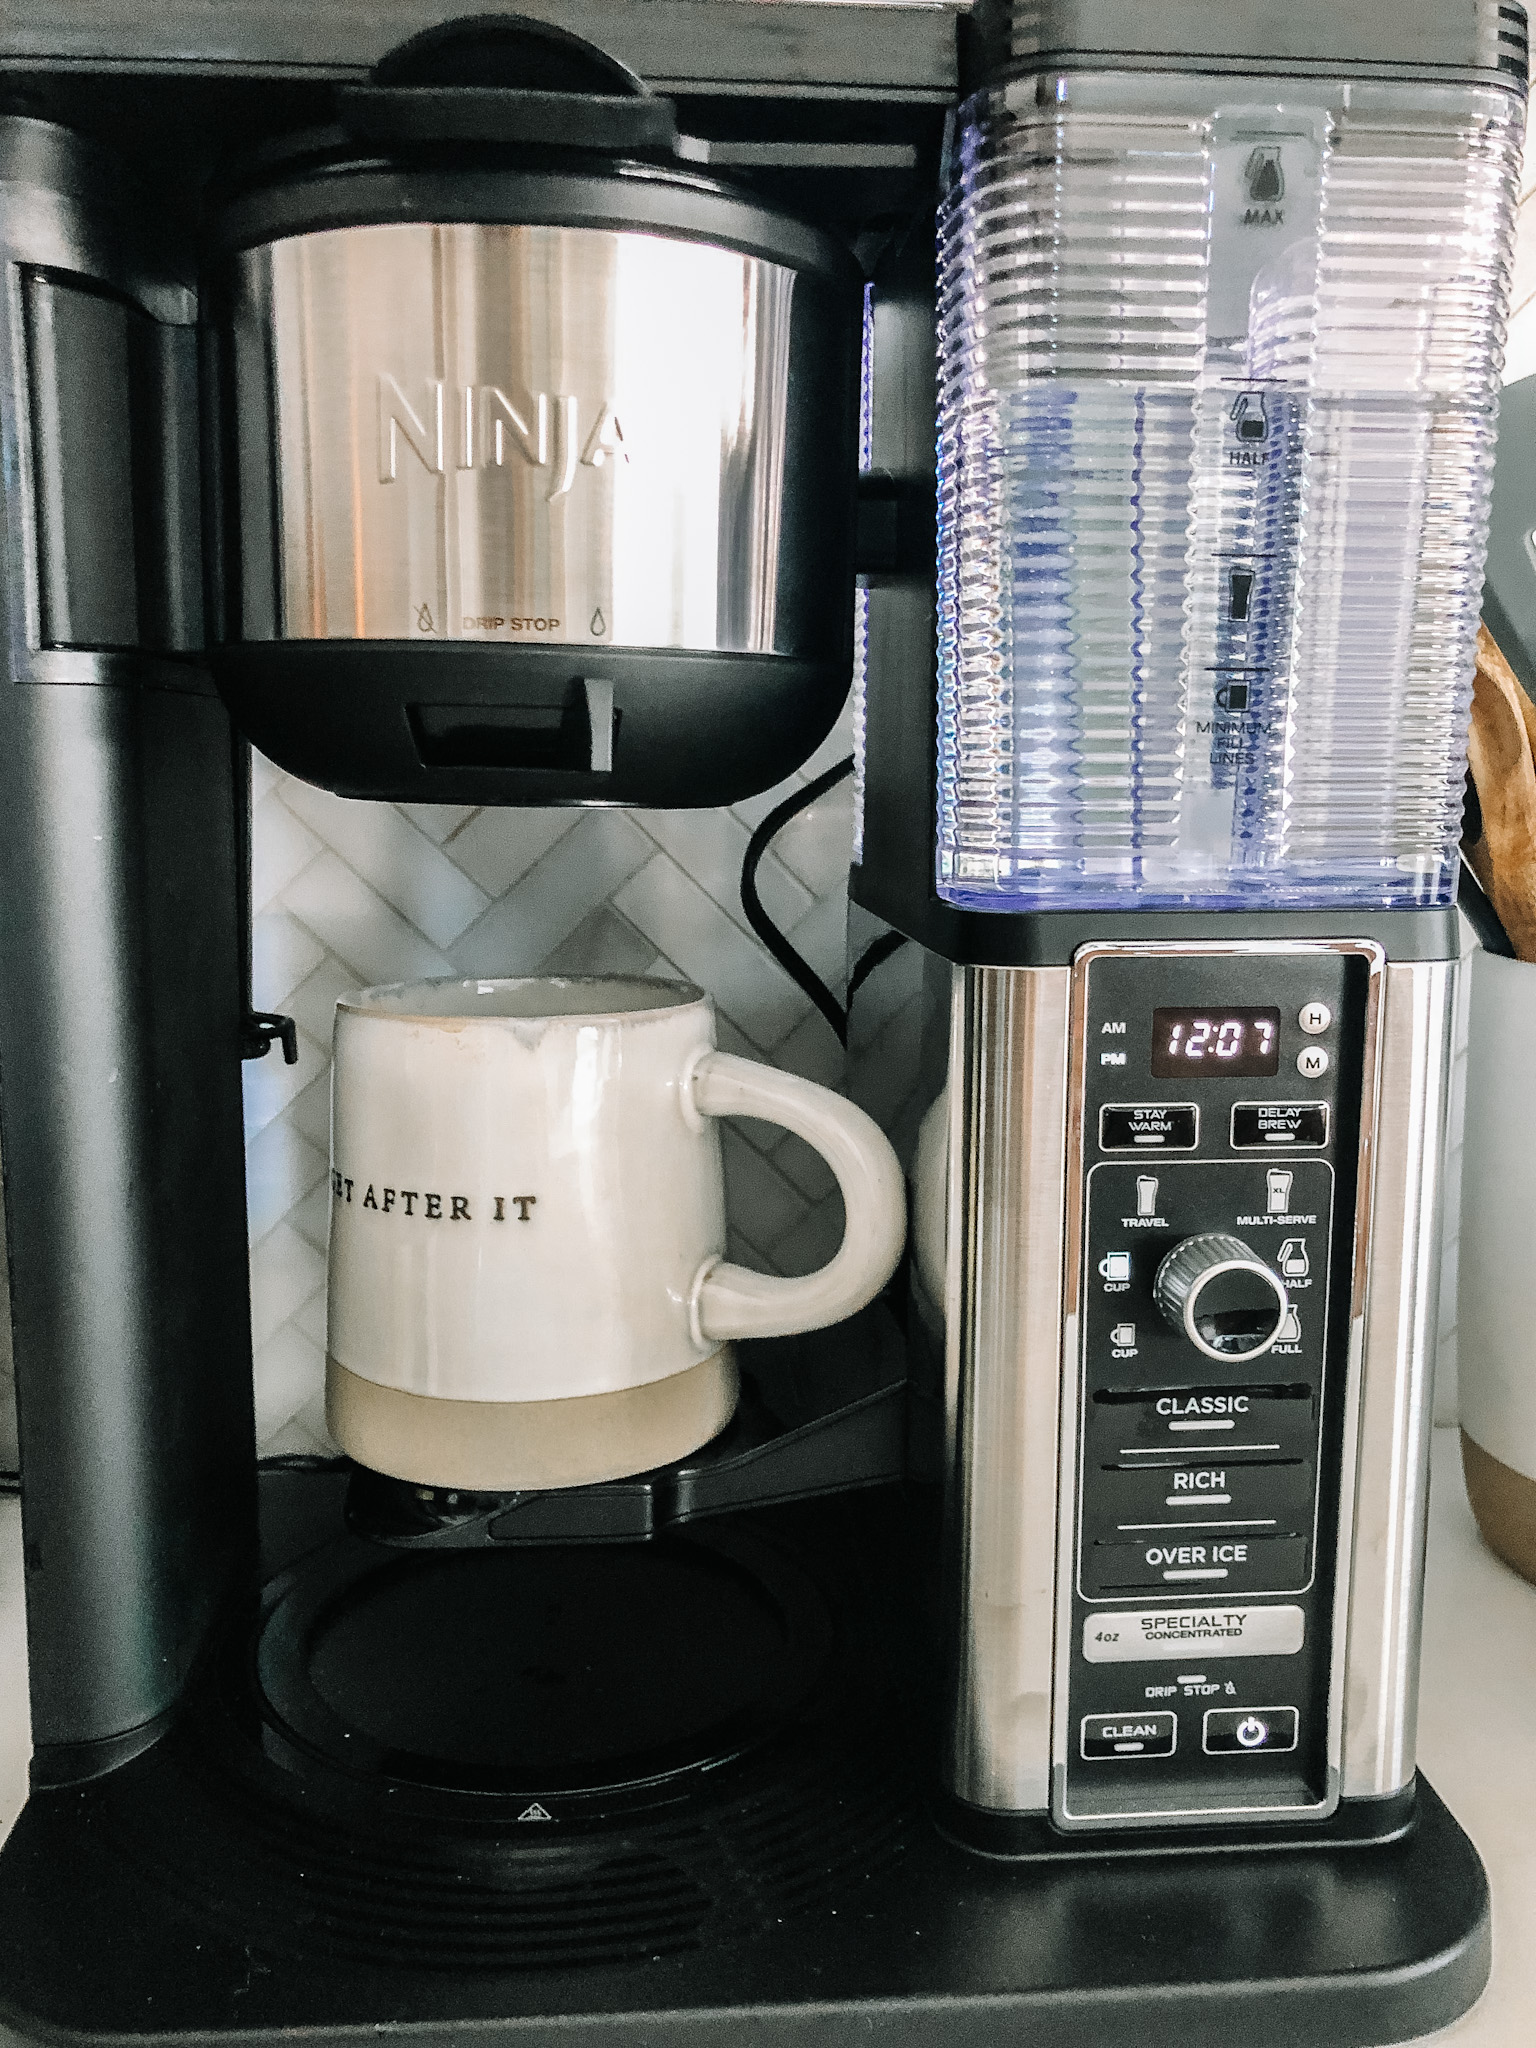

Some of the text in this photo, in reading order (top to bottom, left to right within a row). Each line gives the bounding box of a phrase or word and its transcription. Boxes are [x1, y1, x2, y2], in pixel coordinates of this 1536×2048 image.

[1243, 208, 1284, 225] MAX
[376, 372, 630, 502] NINJA
[1229, 451, 1270, 466] HALF
[462, 616, 560, 631] DRIP STOP
[1195, 721, 1271, 734] MINIMUM
[1217, 737, 1248, 749] FILL
[1210, 752, 1255, 765] LINES
[1310, 1013, 1322, 1025] H
[1101, 1022, 1126, 1034] AM
[1168, 1021, 1274, 1058] 12:07
[1100, 1053, 1126, 1066] PM
[1306, 1058, 1320, 1070] M
[1133, 1110, 1167, 1120] STAY
[1258, 1108, 1302, 1118] DELAY
[1128, 1121, 1171, 1132] WARM
[1258, 1119, 1302, 1130] BREW
[363, 1183, 472, 1221] AFTER
[493, 1195, 537, 1221] IT
[1121, 1217, 1170, 1228] TRAVEL
[1236, 1214, 1317, 1226] MULTI-SERVE
[1103, 1282, 1131, 1293] CUP
[1111, 1349, 1139, 1359] CUP
[1270, 1344, 1303, 1355] FULL
[1156, 1395, 1250, 1416] CLASSIC
[1173, 1471, 1226, 1490] RICH
[1145, 1544, 1248, 1566] OVER ICE
[1141, 1614, 1248, 1631] SPECIALTY
[1145, 1628, 1243, 1641] CONCENTRATED
[1145, 1684, 1220, 1698] DRIP STOP
[1102, 1725, 1158, 1739] CLEAN
